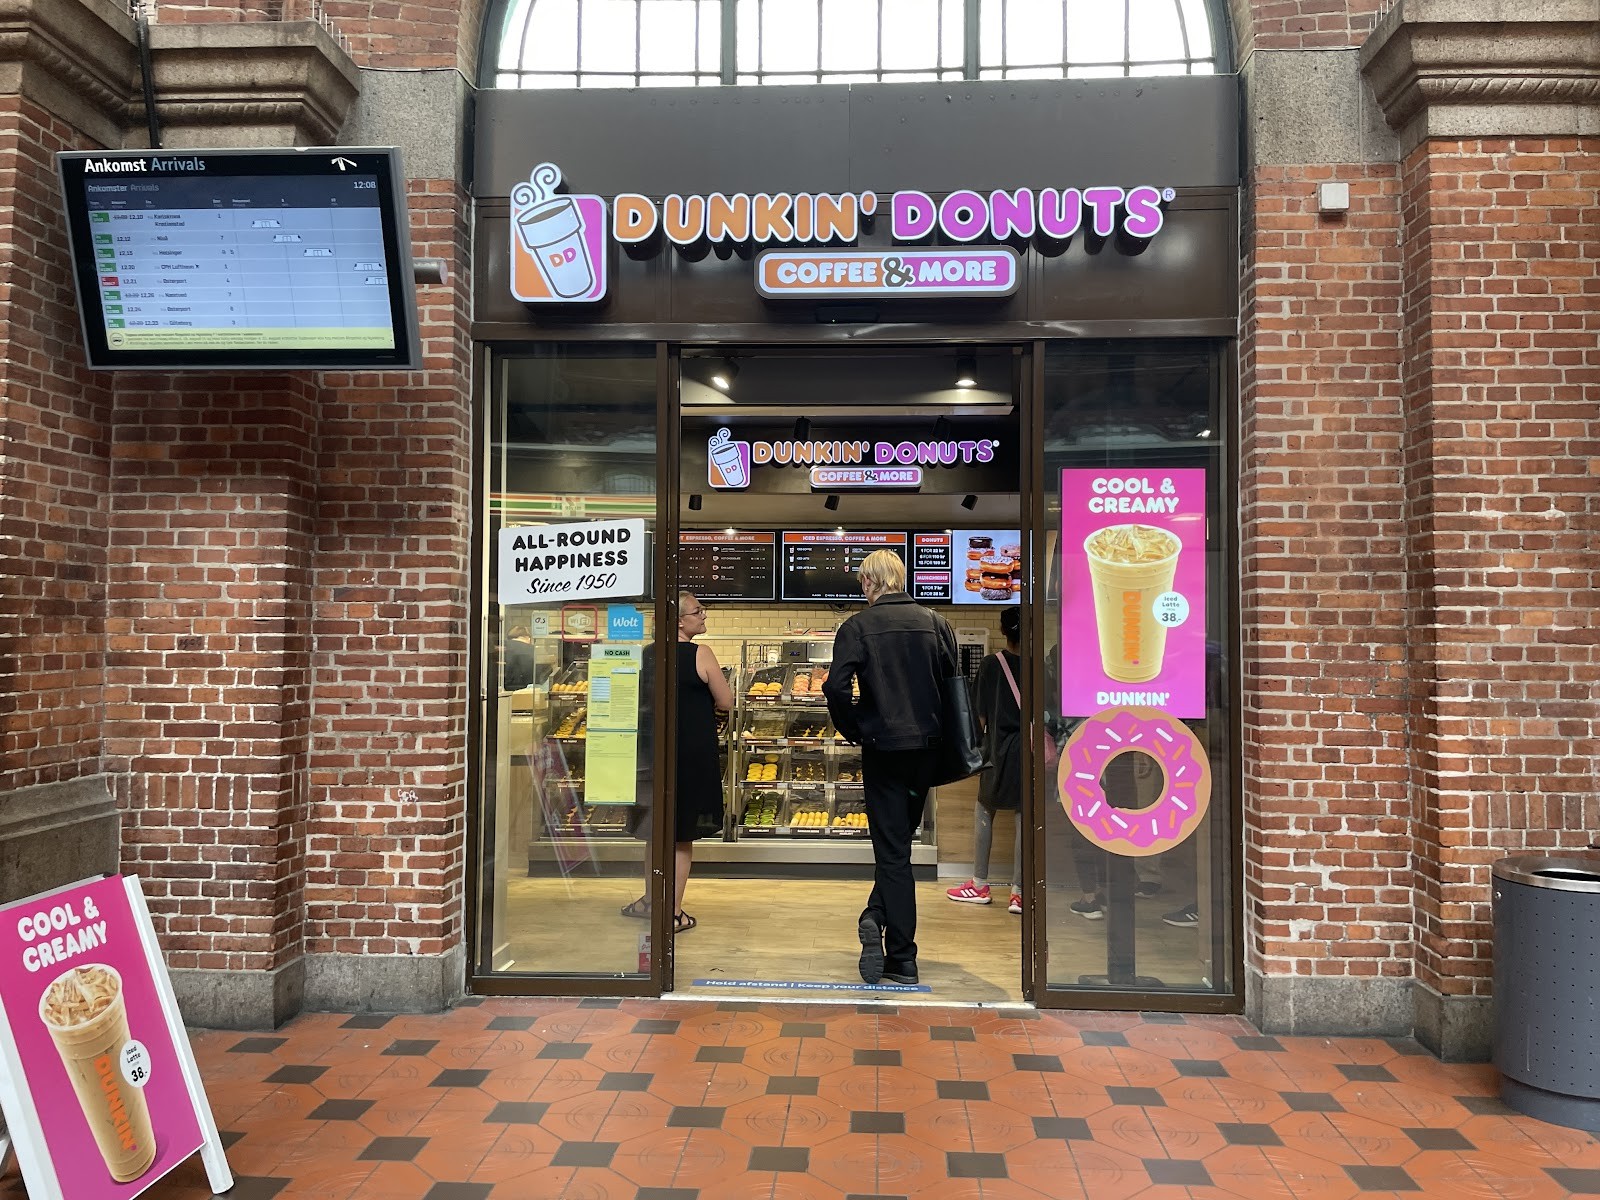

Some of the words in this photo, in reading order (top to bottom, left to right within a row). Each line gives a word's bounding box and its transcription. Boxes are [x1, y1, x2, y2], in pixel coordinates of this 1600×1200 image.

[84, 158, 147, 173] Ankomst
[151, 156, 206, 171] Arrivals
[88, 184, 128, 192] Ankomster
[130, 183, 160, 191] Arrivals
[353, 181, 377, 189] 12:08
[612, 190, 878, 245] DUNKIN'
[891, 186, 1163, 241] DONUTS
[549, 247, 577, 268] DD
[777, 261, 877, 284] COFFEE
[882, 257, 915, 288] &
[918, 260, 997, 283] MORE
[752, 440, 870, 464] DUNKIN'
[874, 440, 994, 464] DONUTS
[818, 471, 862, 482] COFFEE
[879, 470, 913, 481] MORE
[1091, 477, 1155, 494] COOL
[1160, 477, 1176, 494] &
[1088, 496, 1180, 514] CREAMY
[512, 528, 631, 551] ALL-ROUND
[515, 550, 629, 573] HAPPINESS
[527, 577, 571, 594] Since
[575, 572, 617, 591] 1950
[612, 617, 639, 628] Wolt
[1096, 691, 1170, 706] DUNKIN'
[17, 902, 81, 942] COOL
[83, 896, 100, 920] &
[22, 920, 107, 973] CREAMY
[705, 979, 736, 987] Hold
[739, 980, 787, 988] afstand
[797, 982, 832, 990] Keep
[863, 984, 919, 992] distance
